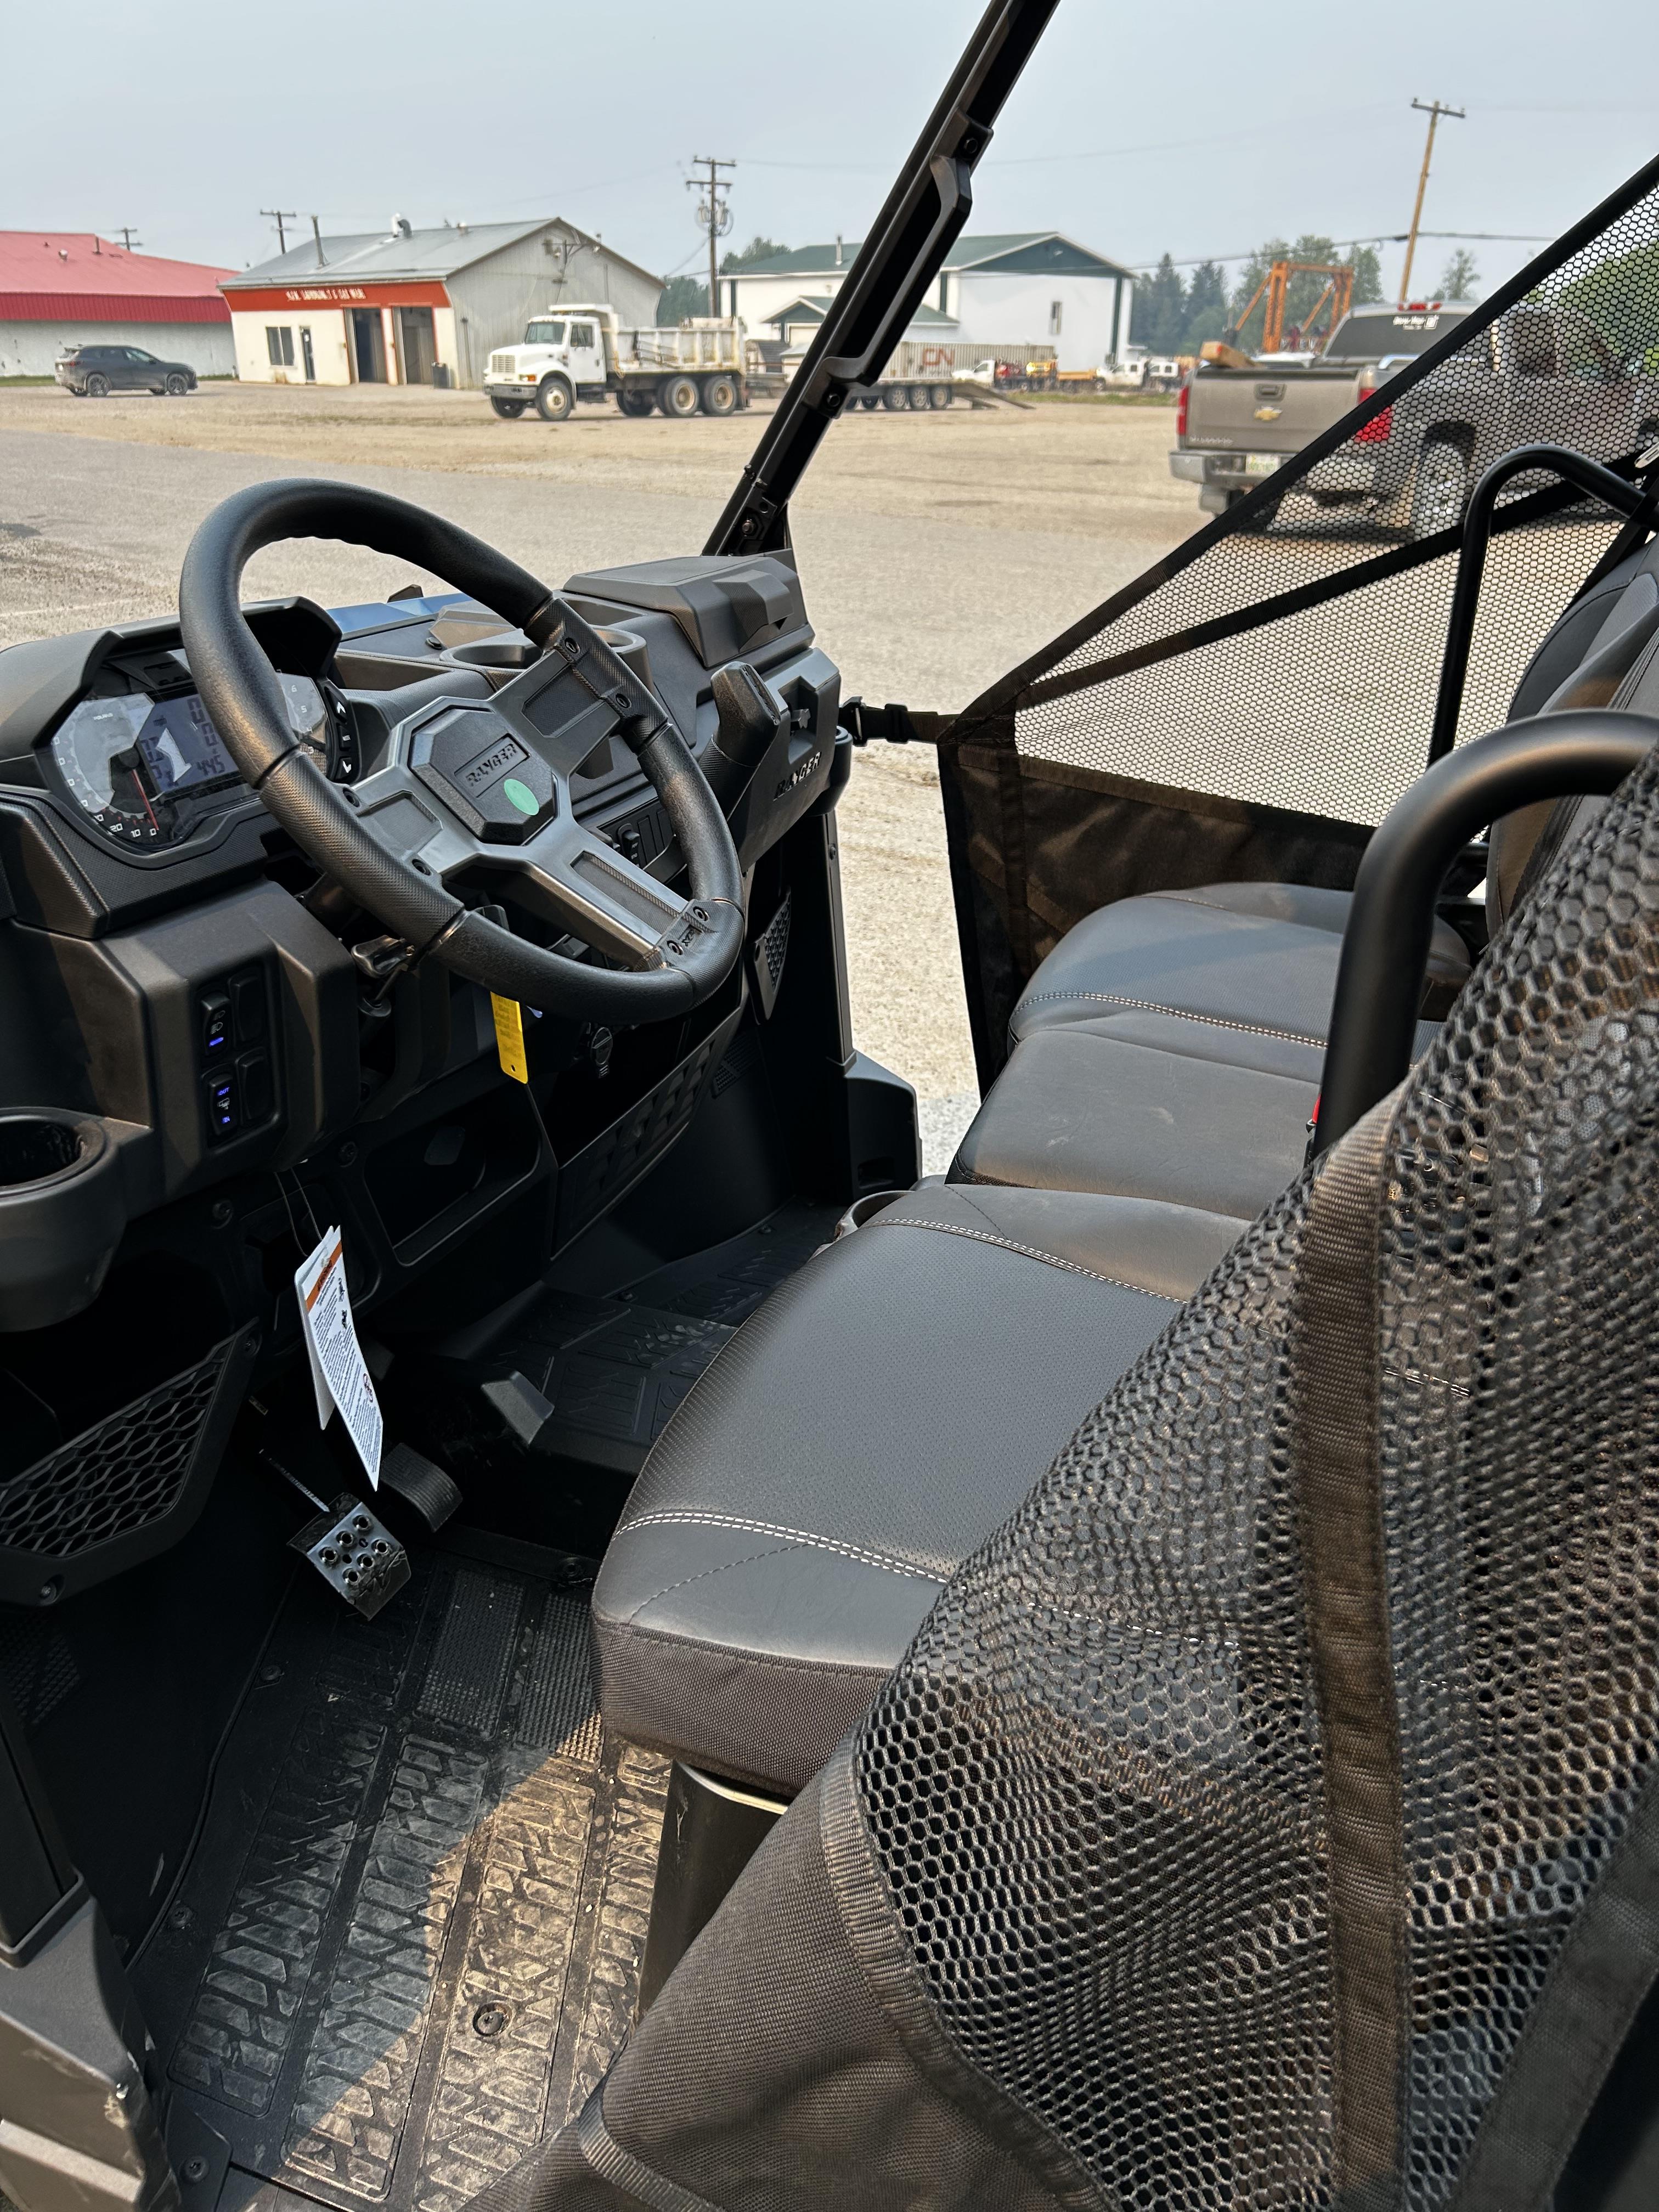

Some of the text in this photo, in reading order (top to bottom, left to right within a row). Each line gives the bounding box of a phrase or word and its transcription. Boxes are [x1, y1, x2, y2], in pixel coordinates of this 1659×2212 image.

[922, 348, 955, 366] CN
[301, 705, 307, 713] 5
[465, 743, 517, 787] RANGER
[773, 751, 822, 801] RANGER
[110, 823, 123, 832] 20
[149, 828, 157, 836] 0
[131, 829, 141, 838] 10
[217, 1087, 229, 1096] OUT
